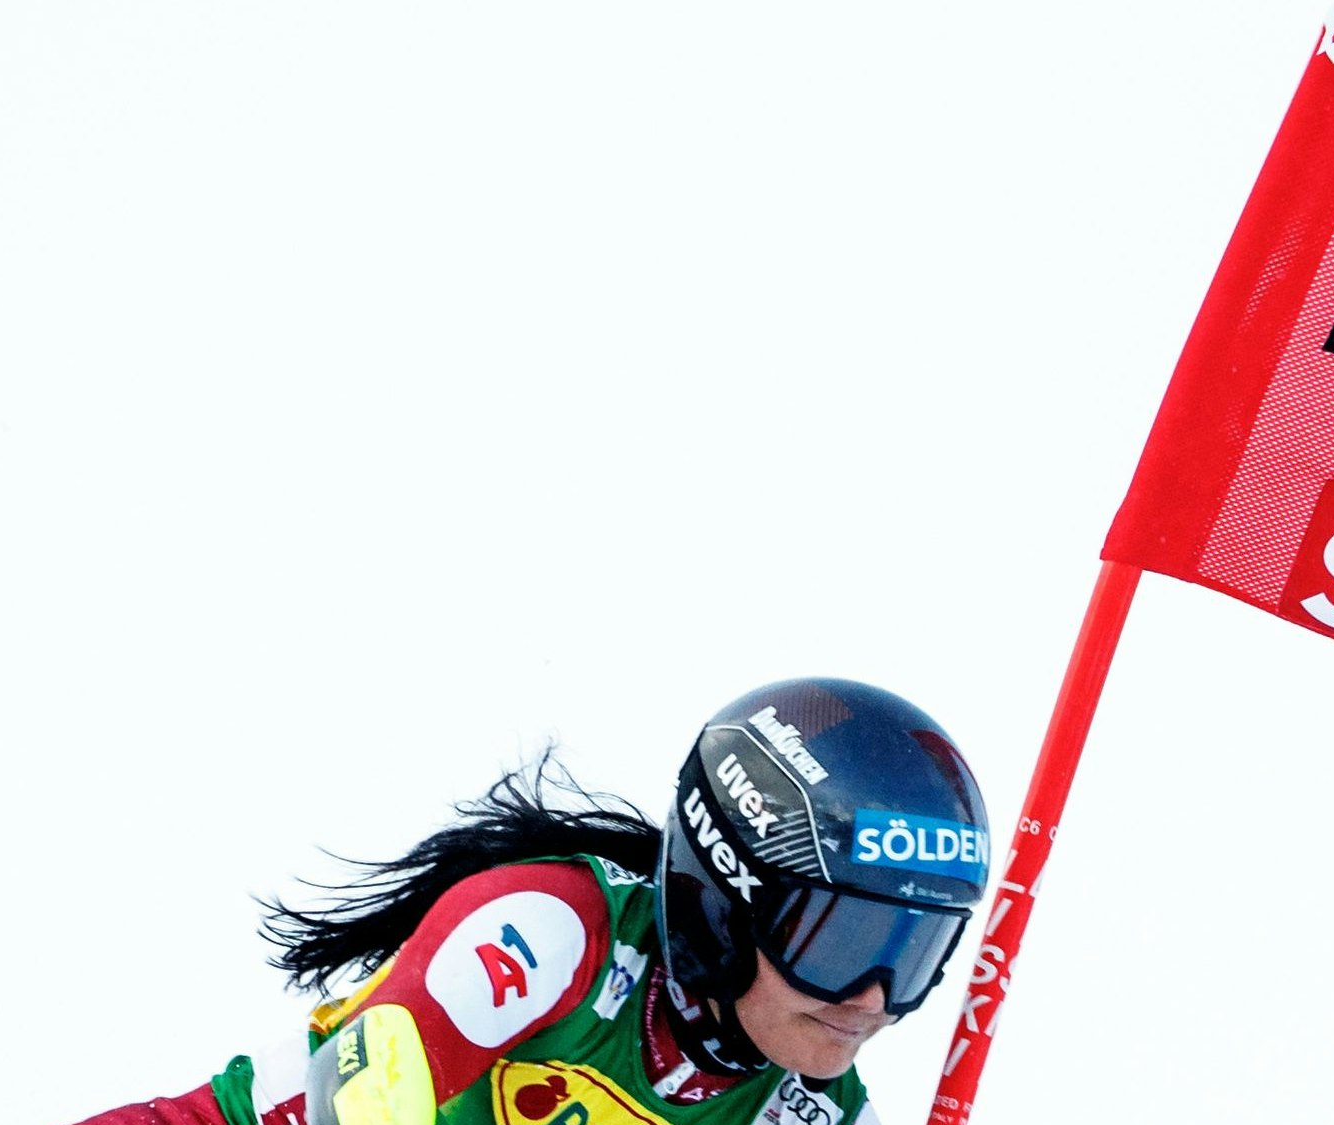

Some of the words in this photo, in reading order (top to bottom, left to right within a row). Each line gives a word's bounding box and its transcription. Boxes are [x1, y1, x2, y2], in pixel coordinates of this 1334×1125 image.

[716, 753, 779, 838] uvex
[682, 787, 764, 903] uvex
[856, 819, 988, 865] SÖLDEN
